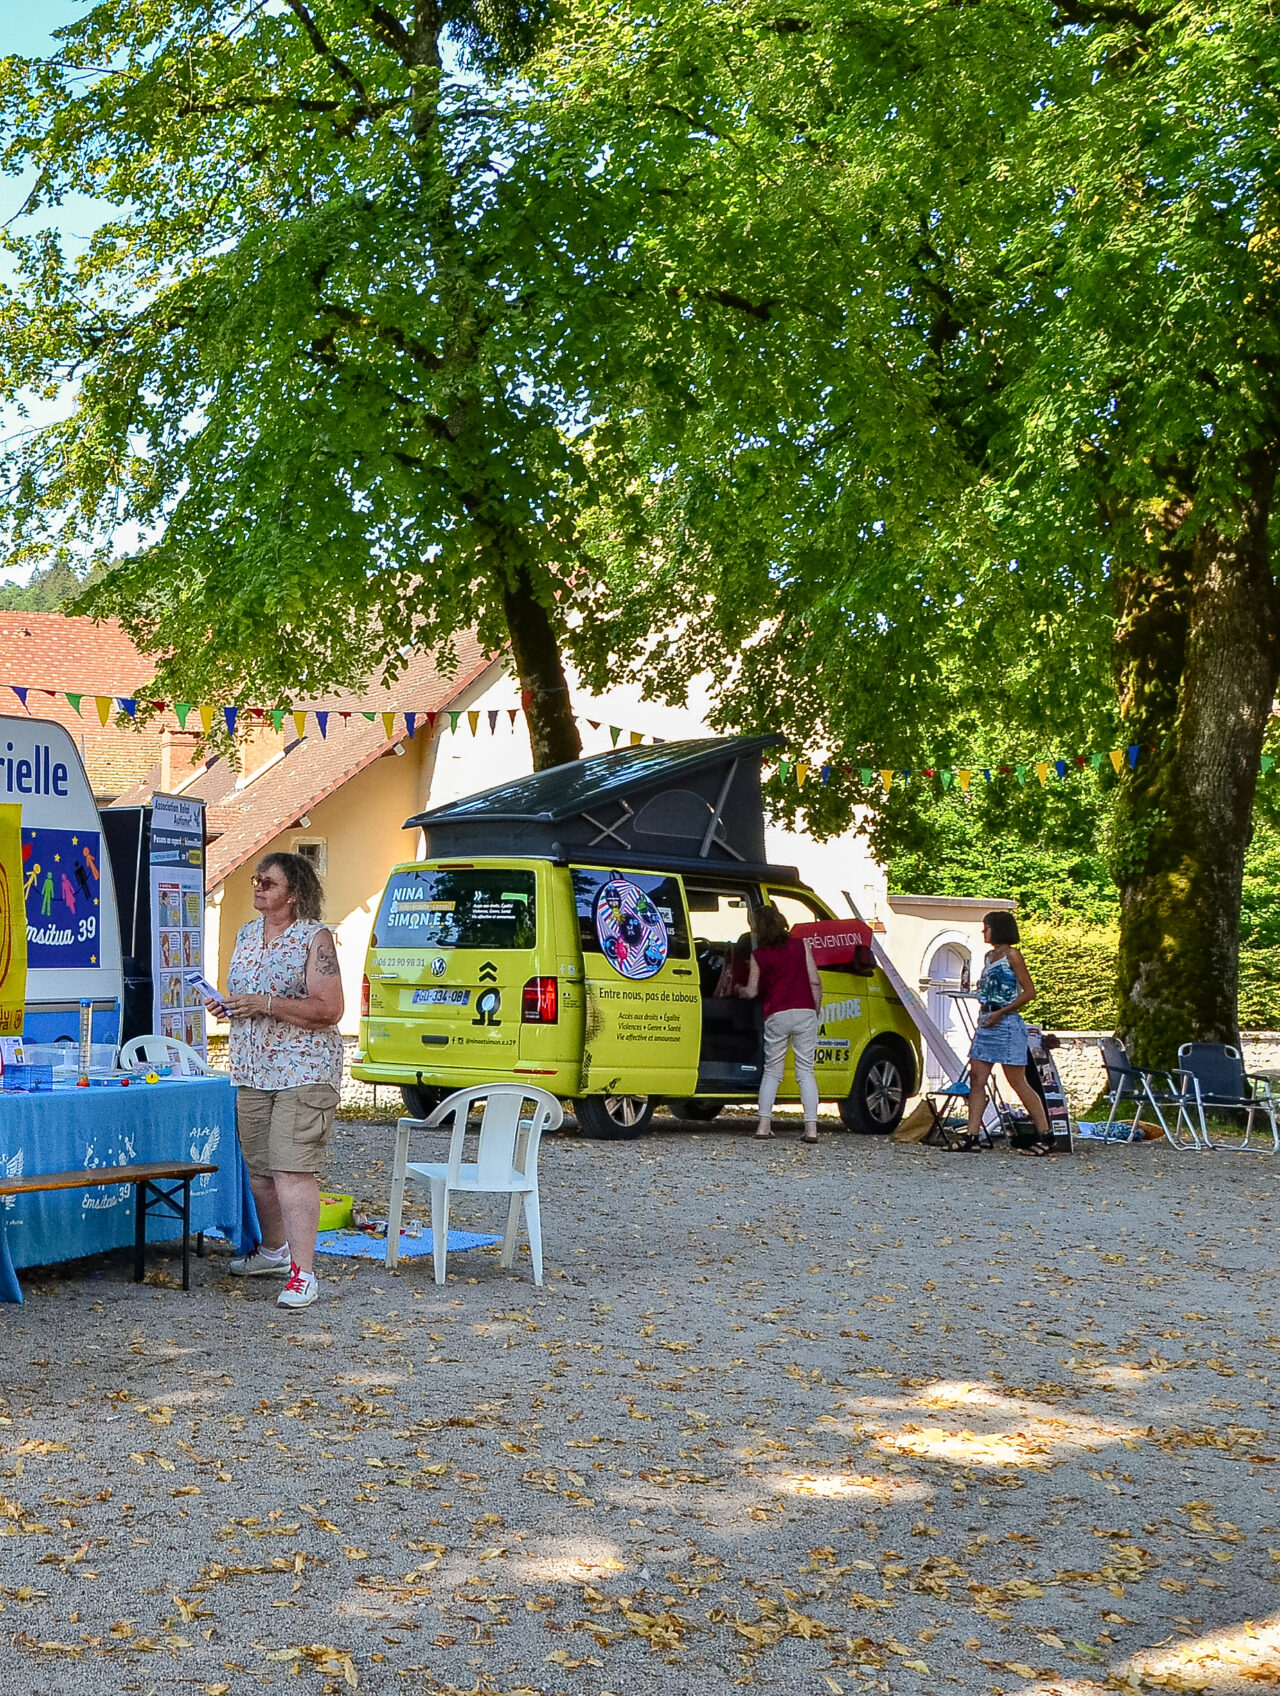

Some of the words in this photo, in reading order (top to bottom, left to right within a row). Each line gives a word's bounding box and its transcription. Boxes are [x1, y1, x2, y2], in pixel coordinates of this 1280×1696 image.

[393, 887, 424, 901] NINA
[390, 901, 398, 914] &
[26, 918, 75, 946] msitua
[78, 915, 96, 942] 39
[599, 987, 621, 999] Entre
[622, 991, 643, 1001] nous,
[645, 992, 659, 1003] pas
[660, 990, 670, 1002] de
[671, 992, 698, 1003] tabous
[119, 1183, 131, 1202] 39
